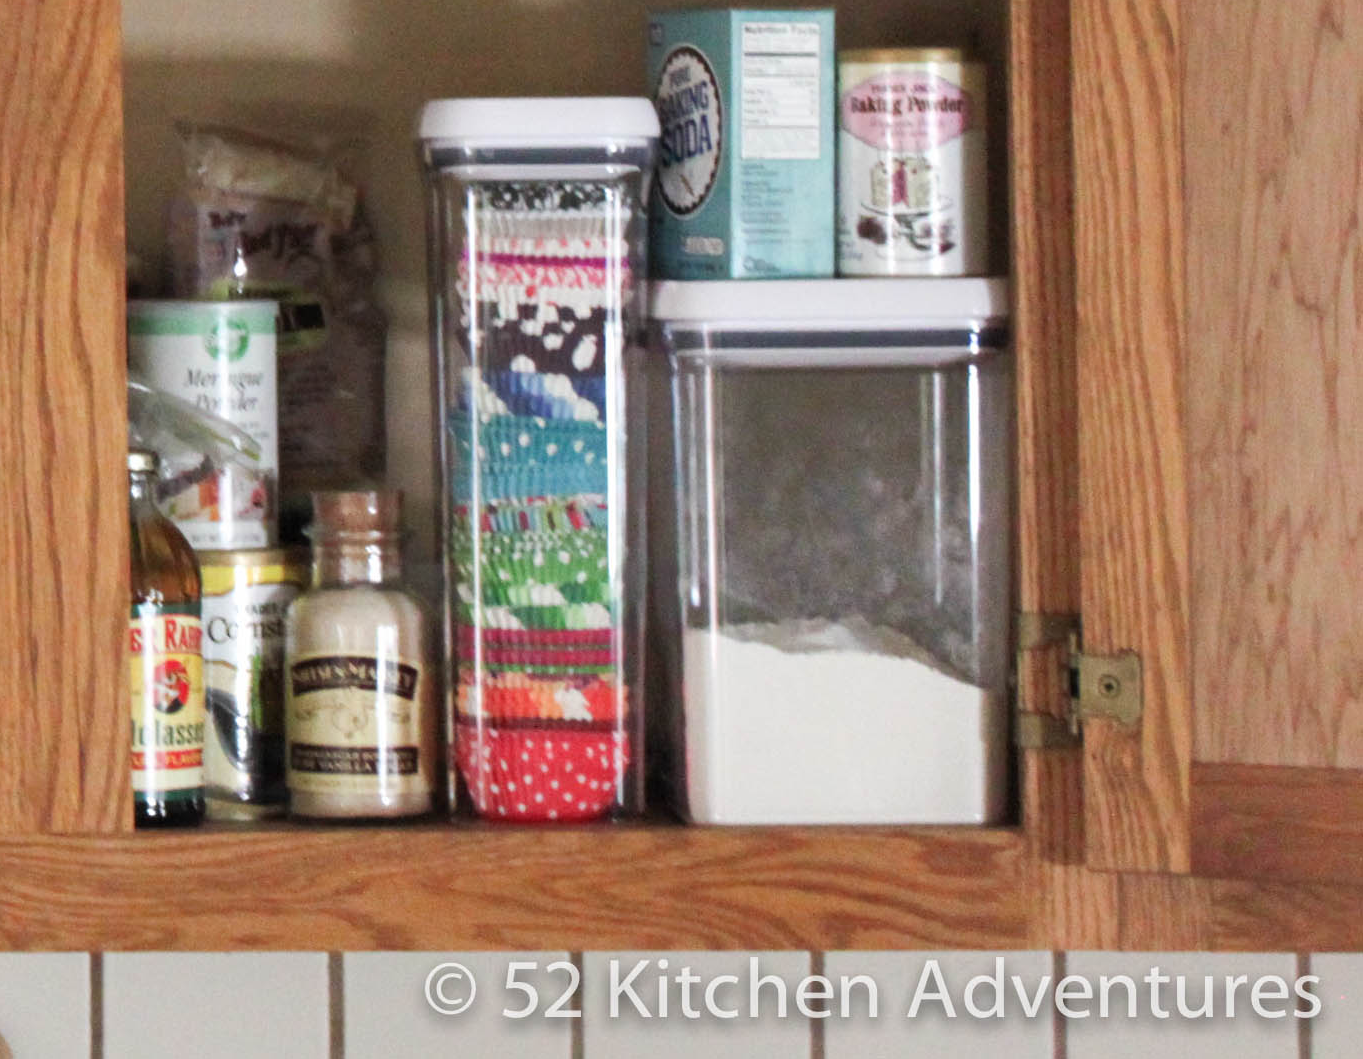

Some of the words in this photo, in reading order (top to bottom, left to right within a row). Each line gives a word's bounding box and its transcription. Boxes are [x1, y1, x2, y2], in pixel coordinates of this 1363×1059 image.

[662, 113, 713, 167] SODA
[183, 369, 264, 391] Merngue
[193, 393, 259, 414] Poder
